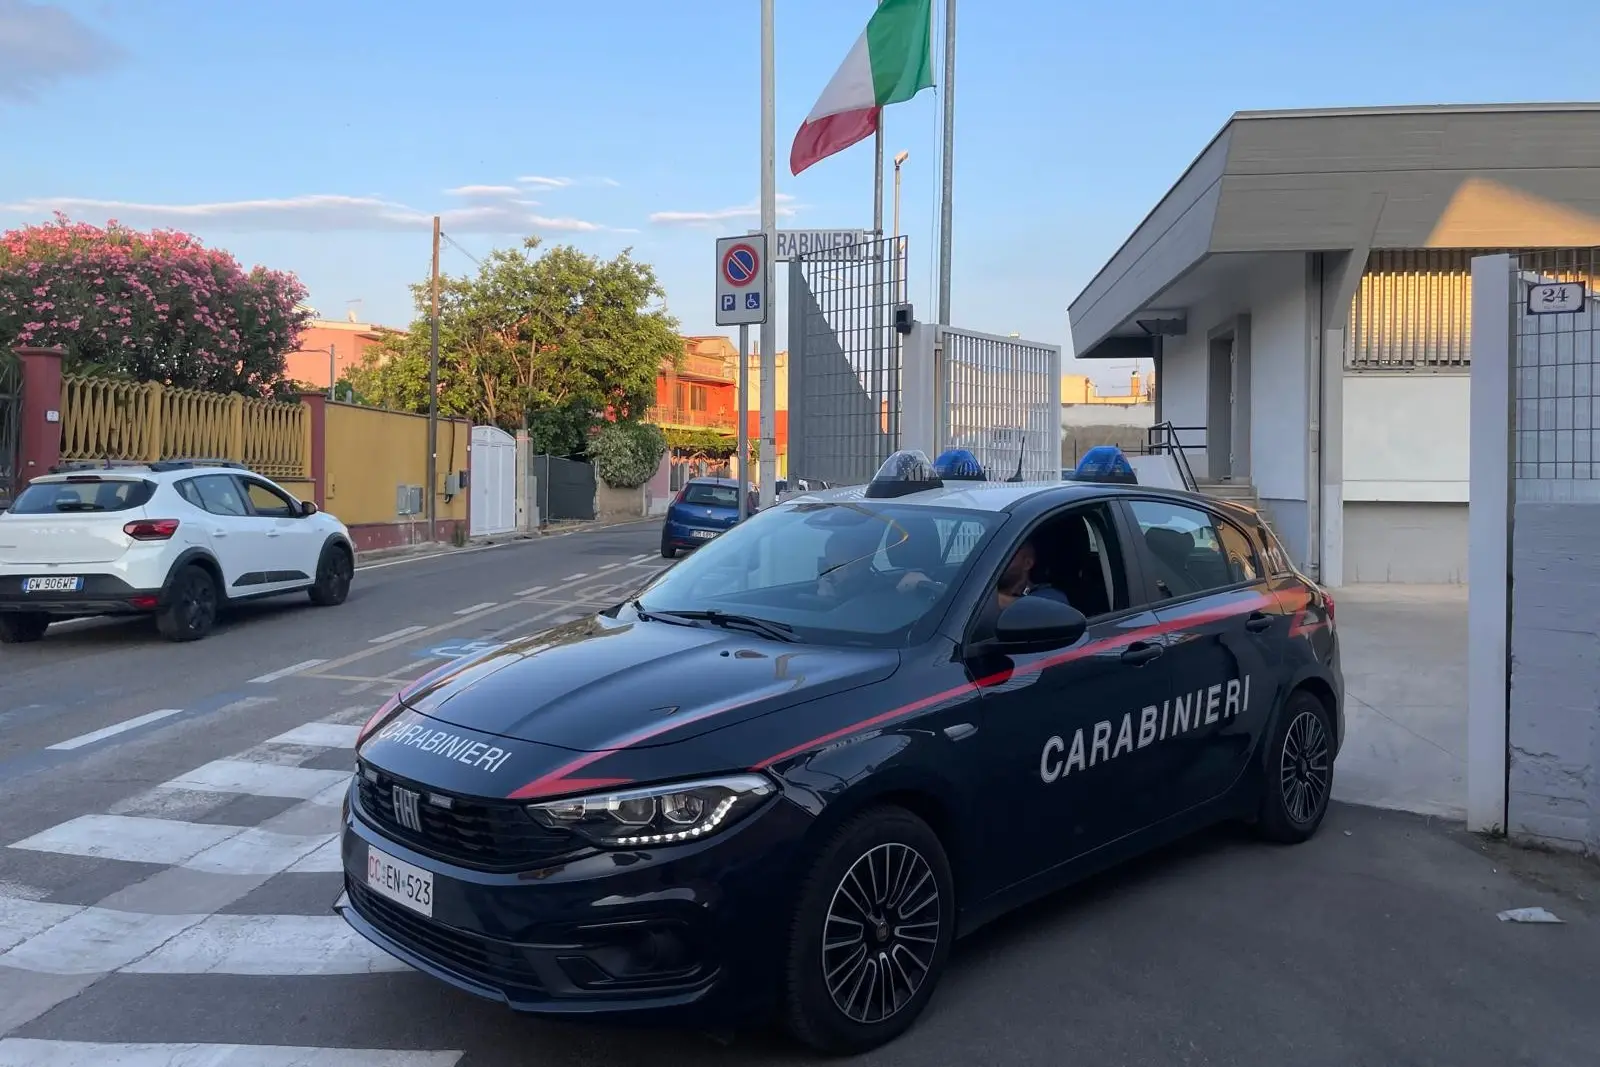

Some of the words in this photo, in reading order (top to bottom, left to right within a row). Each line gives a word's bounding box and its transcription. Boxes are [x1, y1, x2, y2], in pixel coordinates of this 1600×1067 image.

[776, 232, 858, 256] RABINIERI
[724, 296, 734, 310] P
[1543, 287, 1569, 302] 24
[379, 721, 512, 773] CARABINIERI
[1040, 674, 1250, 783] CARABINIERI
[393, 785, 422, 832] FIAT
[369, 855, 381, 882] CC
[386, 865, 400, 893] EN
[407, 875, 431, 906] 523
